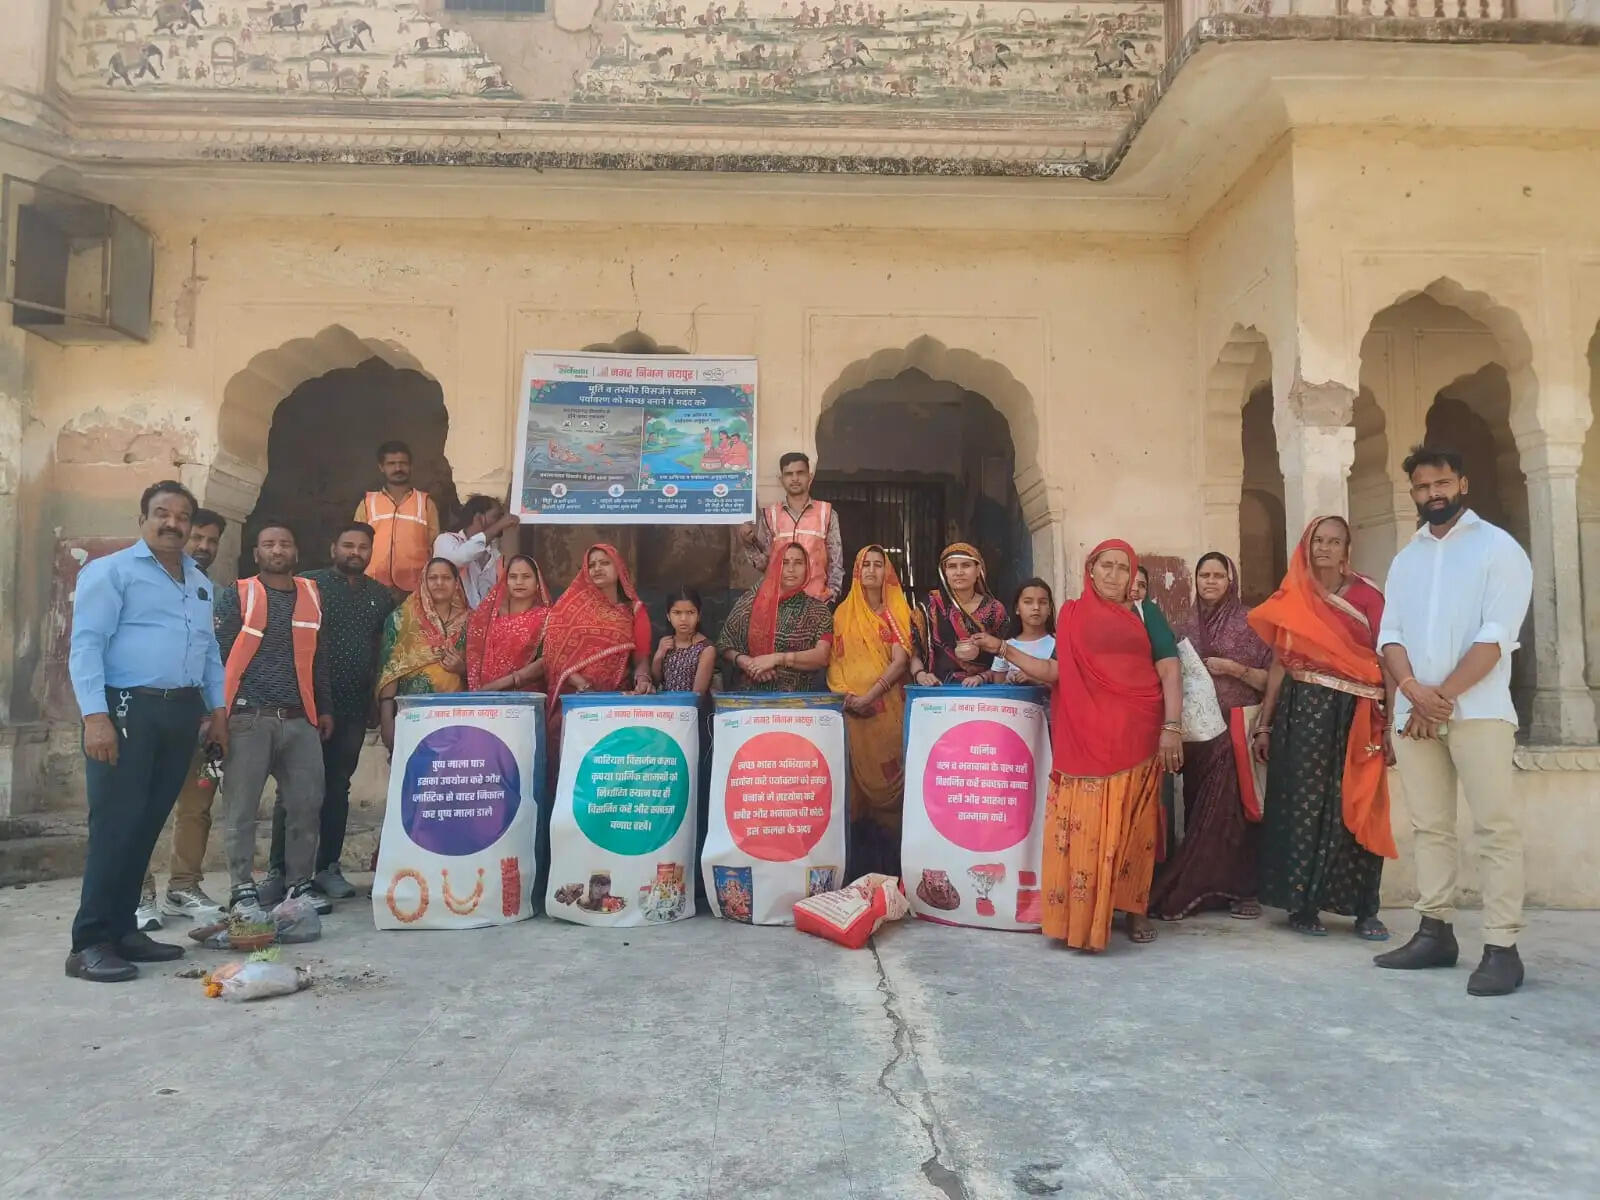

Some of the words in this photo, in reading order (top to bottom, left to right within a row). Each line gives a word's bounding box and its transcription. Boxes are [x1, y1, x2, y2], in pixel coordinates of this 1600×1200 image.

[611, 368, 632, 377] नगर
[637, 366, 664, 378] निगम
[667, 369, 693, 381] जयपुर
[588, 384, 604, 394] मूर्ति
[641, 386, 670, 395] विसर्जन
[580, 394, 610, 403] पर्यावरण
[612, 396, 622, 404] को
[970, 744, 996, 755] धार्मिक
[432, 760, 445, 771] पुष्प
[447, 760, 468, 768] माला
[471, 760, 486, 768] पात्र
[593, 754, 624, 764] नारियल
[626, 754, 656, 766] विसर्जन
[757, 760, 776, 769] भारत
[778, 758, 810, 768] अभियान
[958, 762, 989, 771] भगवान
[991, 762, 999, 771] के
[417, 777, 438, 786] इसका
[440, 774, 468, 785] उपयोग
[485, 774, 500, 783] और
[592, 772, 613, 784] कृपया
[616, 770, 640, 780] धार्मिक
[669, 771, 678, 781] को
[936, 776, 964, 788] विसर्जित
[412, 791, 444, 802] प्लास्टिक
[446, 791, 454, 801] से
[477, 790, 505, 800] निकाल
[597, 787, 627, 797] निर्धारित
[629, 788, 650, 797] स्थान
[652, 789, 661, 797] पर
[663, 787, 670, 798] ही
[964, 794, 980, 804] और
[1008, 797, 1016, 806] का
[588, 803, 617, 814] विसर्जित
[634, 803, 648, 813] और
[753, 808, 767, 819] और
[770, 810, 798, 818] भगवान
[422, 810, 435, 818] कर
[438, 809, 452, 821] पुष्प
[453, 808, 474, 818] माला
[787, 824, 795, 834] के
